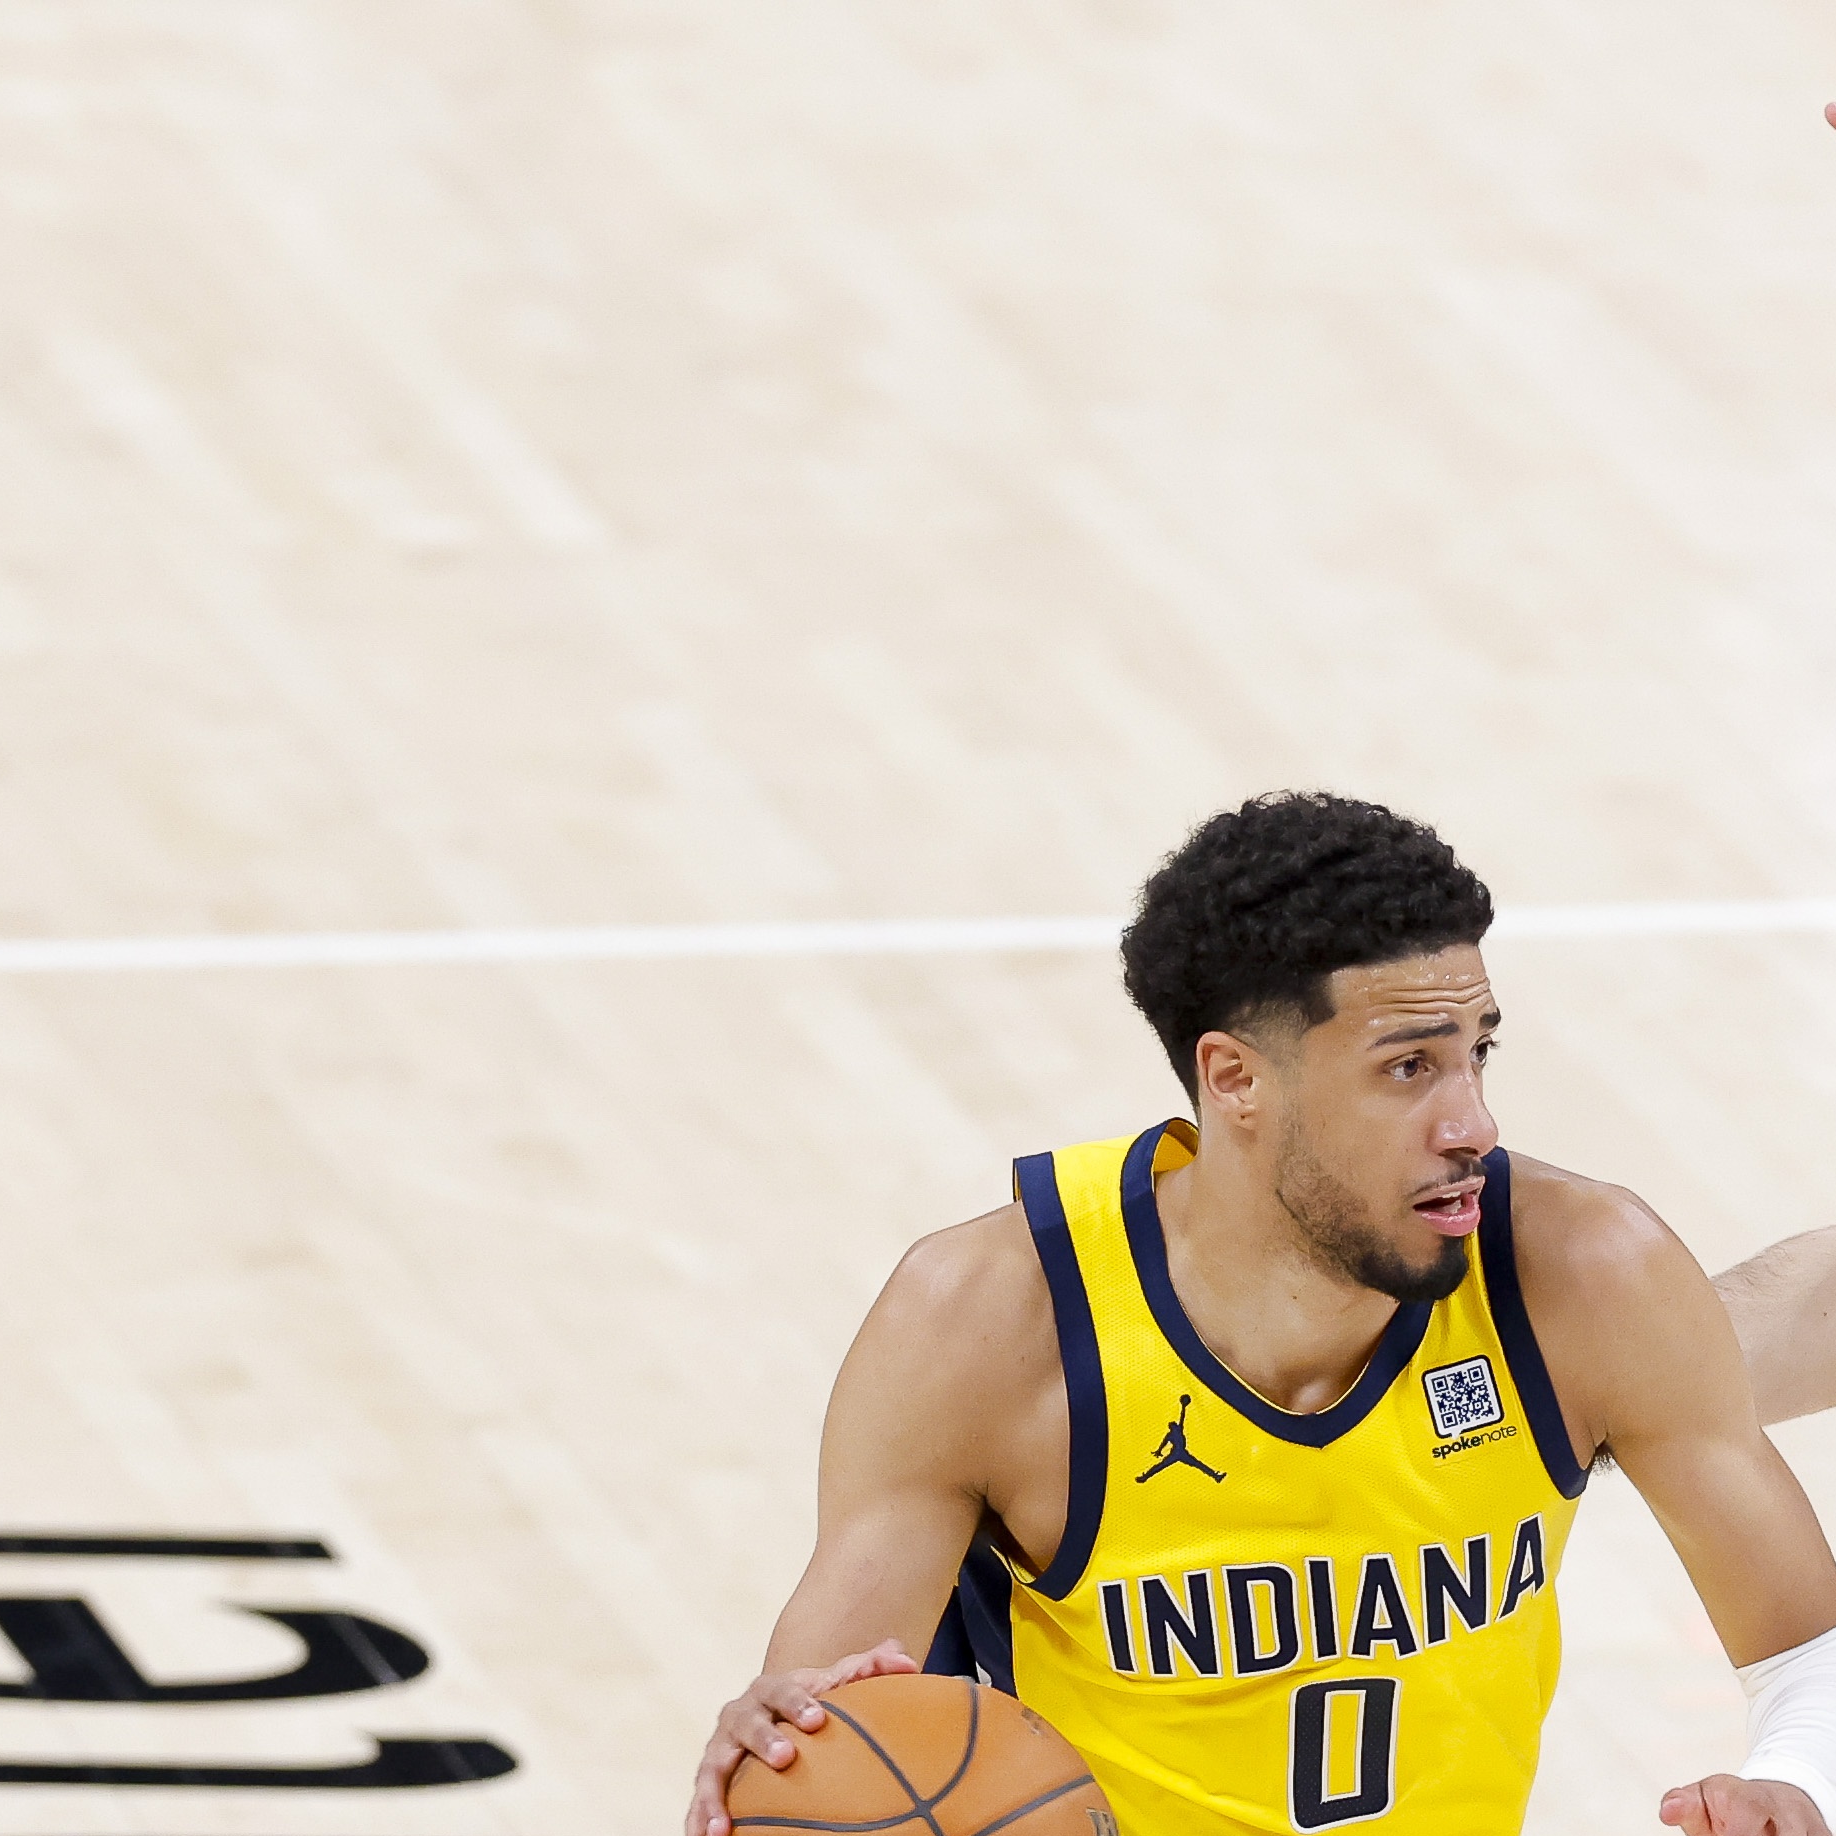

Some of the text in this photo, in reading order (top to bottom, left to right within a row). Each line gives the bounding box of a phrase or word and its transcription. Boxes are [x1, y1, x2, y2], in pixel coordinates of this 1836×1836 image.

[1431, 1425, 1517, 1459] spokenote
[1099, 1512, 1547, 1678] INDIANA
[1288, 1677, 1402, 1835] 0
